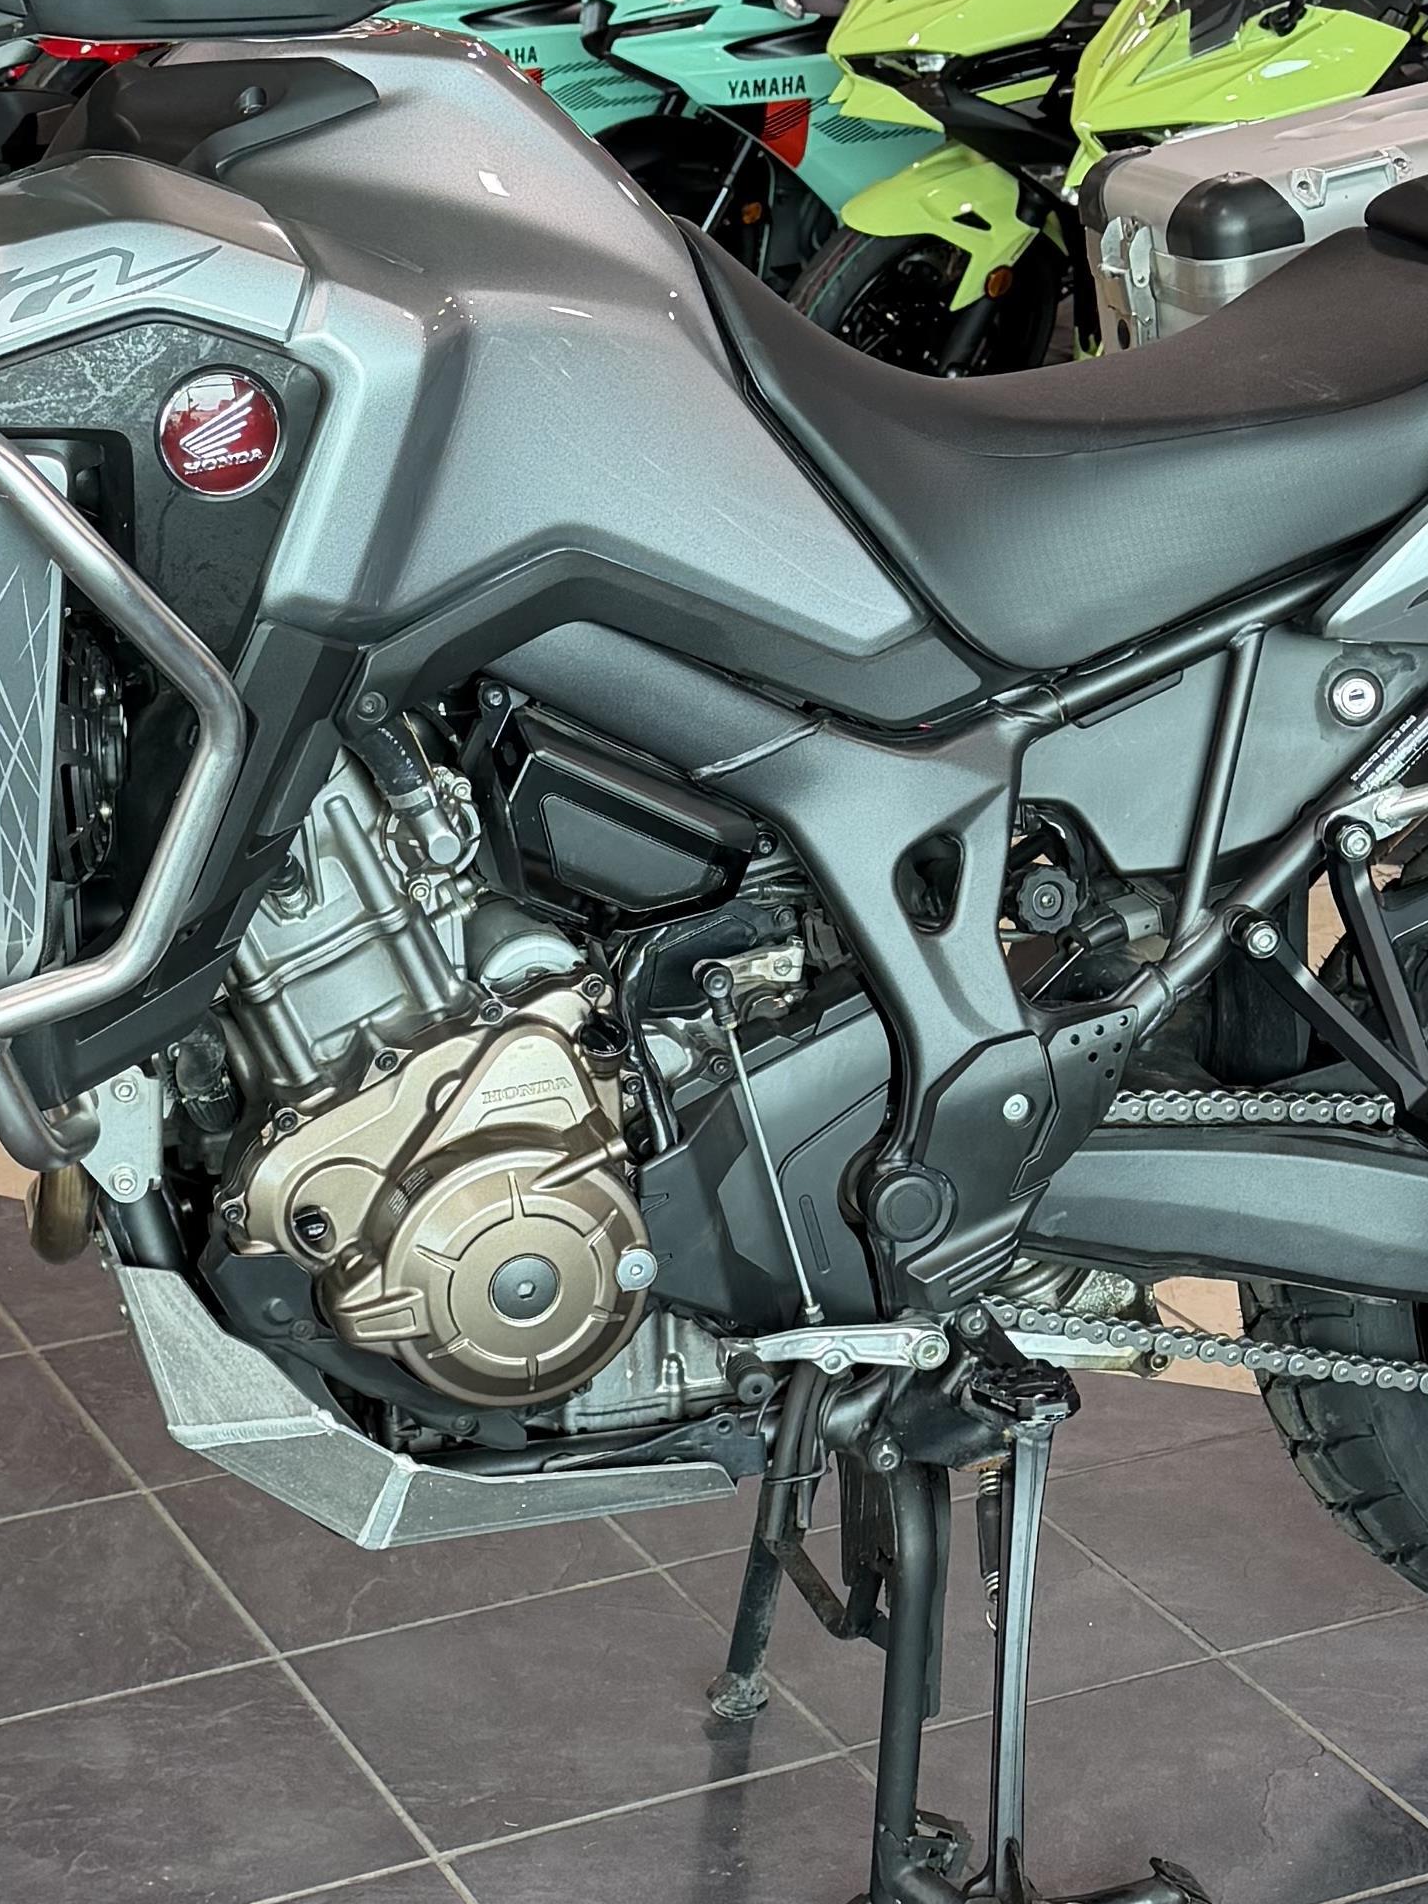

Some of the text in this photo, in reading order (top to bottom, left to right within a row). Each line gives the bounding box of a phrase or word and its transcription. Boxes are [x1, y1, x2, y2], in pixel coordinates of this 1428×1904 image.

[505, 46, 538, 64] AHA
[728, 75, 806, 98] YAMAHA
[183, 448, 266, 476] HONDA
[481, 1076, 572, 1104] HONDA
